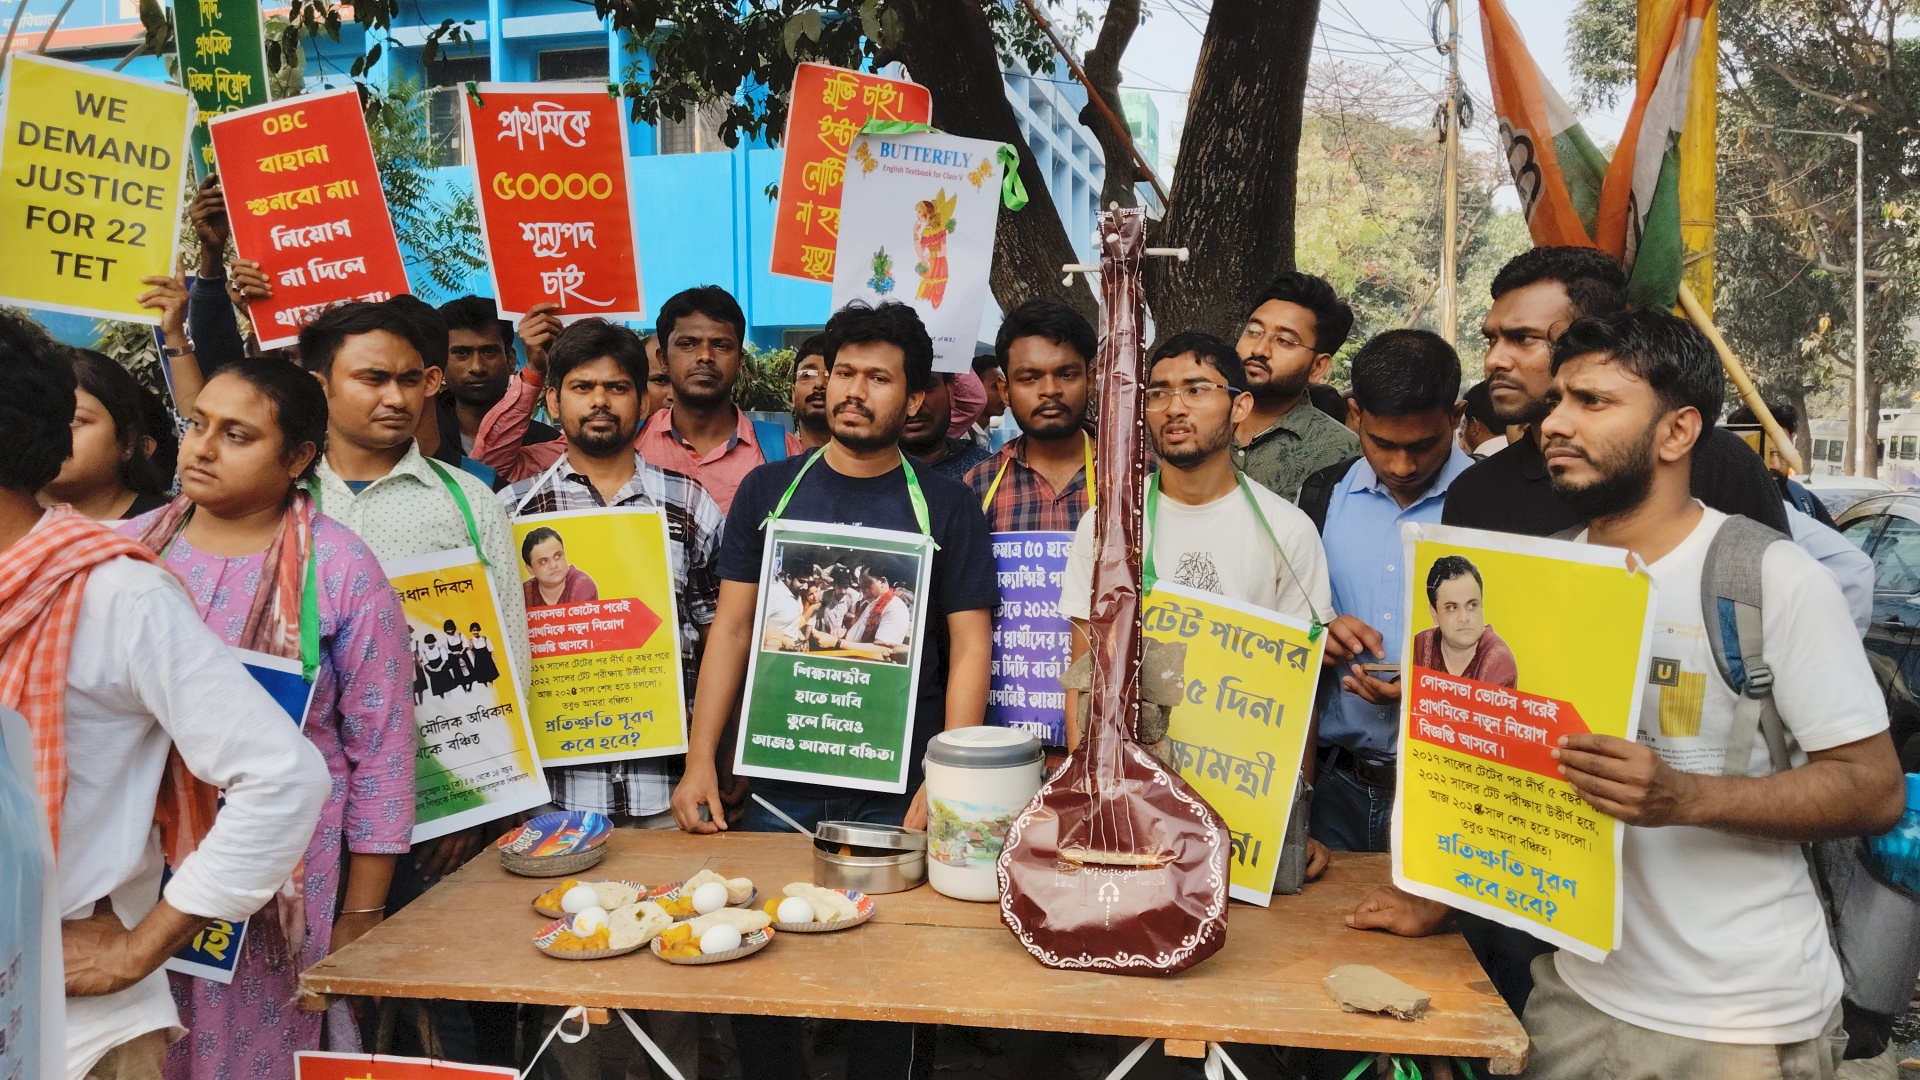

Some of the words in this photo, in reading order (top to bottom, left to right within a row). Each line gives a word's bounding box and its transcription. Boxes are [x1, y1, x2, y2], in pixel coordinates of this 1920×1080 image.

[196, 30, 232, 65] প্রাথমিক
[215, 67, 251, 104] নিয়োগ
[823, 72, 860, 112] মুক্তি
[75, 90, 128, 123] WE
[262, 110, 308, 136] OBC
[497, 101, 591, 150] প্রাথমিকে
[817, 115, 861, 157] ইন্টা
[18, 121, 171, 171] DEMAND
[256, 144, 329, 173] বাহানা
[880, 141, 973, 168] BUTTERFLY
[16, 164, 165, 211] JUSTICE
[493, 171, 613, 200] ৫০০০০
[883, 164, 904, 174] English
[905, 167, 932, 177] Textbook
[943, 172, 957, 180] Class
[246, 185, 321, 216] শুনবো
[323, 179, 359, 199] না।
[26, 205, 95, 239] FOR
[106, 218, 147, 248] 22
[796, 200, 814, 235] না
[270, 218, 352, 251] নিয়োগ
[518, 222, 596, 258] শূন্যপদ
[50, 250, 117, 282] TET
[277, 267, 306, 287] না
[307, 256, 366, 283] দিলে
[540, 264, 616, 308] চাই
[1024, 540, 1044, 558] ৫০
[433, 579, 475, 598] দিবসে
[526, 607, 566, 622] লোকসভা
[568, 602, 600, 617] ভোটের
[603, 600, 631, 613] পরেই
[528, 624, 565, 639] প্রাথমিকে
[568, 621, 589, 635] নতুন
[592, 618, 624, 632] নিয়োগ
[1143, 601, 1204, 638] টেট
[1209, 620, 1311, 674] পাশের
[547, 660, 569, 671] সালের
[572, 657, 593, 668] টেটের
[596, 657, 608, 666] পর
[610, 653, 625, 664] দীর্ঘ
[627, 655, 633, 663] ৫
[636, 653, 652, 663] বছর
[654, 651, 670, 660] পরে
[553, 673, 575, 684] সালের
[577, 671, 590, 681] টেট
[593, 667, 623, 679] পরীক্ষায়
[626, 664, 646, 677] উত্তীর্ণ
[793, 661, 871, 686] শিক্ষামন্ত্রীর
[1003, 654, 1029, 678] দিদি
[1031, 656, 1061, 679] বার্তা
[1657, 664, 1672, 680] U
[537, 690, 553, 699] আজ
[580, 685, 596, 695] সাল
[598, 682, 612, 693] শেষ
[615, 681, 631, 691] হতে
[562, 701, 580, 711] তবুও
[582, 698, 605, 708] আমরা
[794, 690, 829, 705] হাতে
[831, 691, 863, 709] দাবি
[1216, 675, 1285, 728] দিন।
[1420, 674, 1472, 700] লোকসভা
[1475, 687, 1518, 711] ভোটের
[1522, 699, 1559, 723] পরেই
[420, 715, 463, 738] মৌলিক
[466, 703, 514, 725] অধিকার
[545, 711, 614, 732] প্রতিশ্রুতি
[618, 709, 654, 730] পূরণ
[787, 713, 819, 731] তুলে
[821, 713, 864, 734] দিয়েও
[1418, 718, 1456, 744] বিজ্ঞপ্তি
[1419, 698, 1470, 724] প্রাথমিকে
[1473, 711, 1502, 734] নতুন
[1504, 715, 1548, 745] নিয়োগ
[448, 731, 481, 752] বঞ্চিত
[559, 737, 595, 752] কবে
[599, 731, 641, 750] হবে?
[752, 734, 795, 751] আজও
[799, 739, 847, 757] আমরা
[1412, 748, 1441, 765] ২০১৭
[1443, 756, 1472, 774] সালের
[1475, 762, 1503, 783] টেটের
[1507, 775, 1522, 789] পর
[1525, 777, 1546, 795] দীর্ঘ
[1548, 788, 1557, 799] ৫
[1560, 790, 1582, 807] বছর
[1419, 768, 1448, 787] ২০২২
[1450, 777, 1480, 795] সালের
[1483, 784, 1501, 800] টেট
[1504, 791, 1542, 814] পরীক্ষায়
[1546, 802, 1574, 824] উত্তীর্ণ
[1428, 789, 1449, 805] আজ
[1484, 806, 1504, 822] সাল
[1508, 815, 1527, 829] শেষ
[1530, 821, 1550, 836] হতে
[1460, 818, 1483, 836] তবুও
[1486, 827, 1516, 846] আমরা
[1519, 837, 1552, 861] বঞ্চিত!
[1436, 833, 1525, 877] প্রতিশ্রুতি
[1528, 865, 1578, 898] পূরণ
[1453, 868, 1501, 900] কবে
[1504, 886, 1558, 923] হবে?
